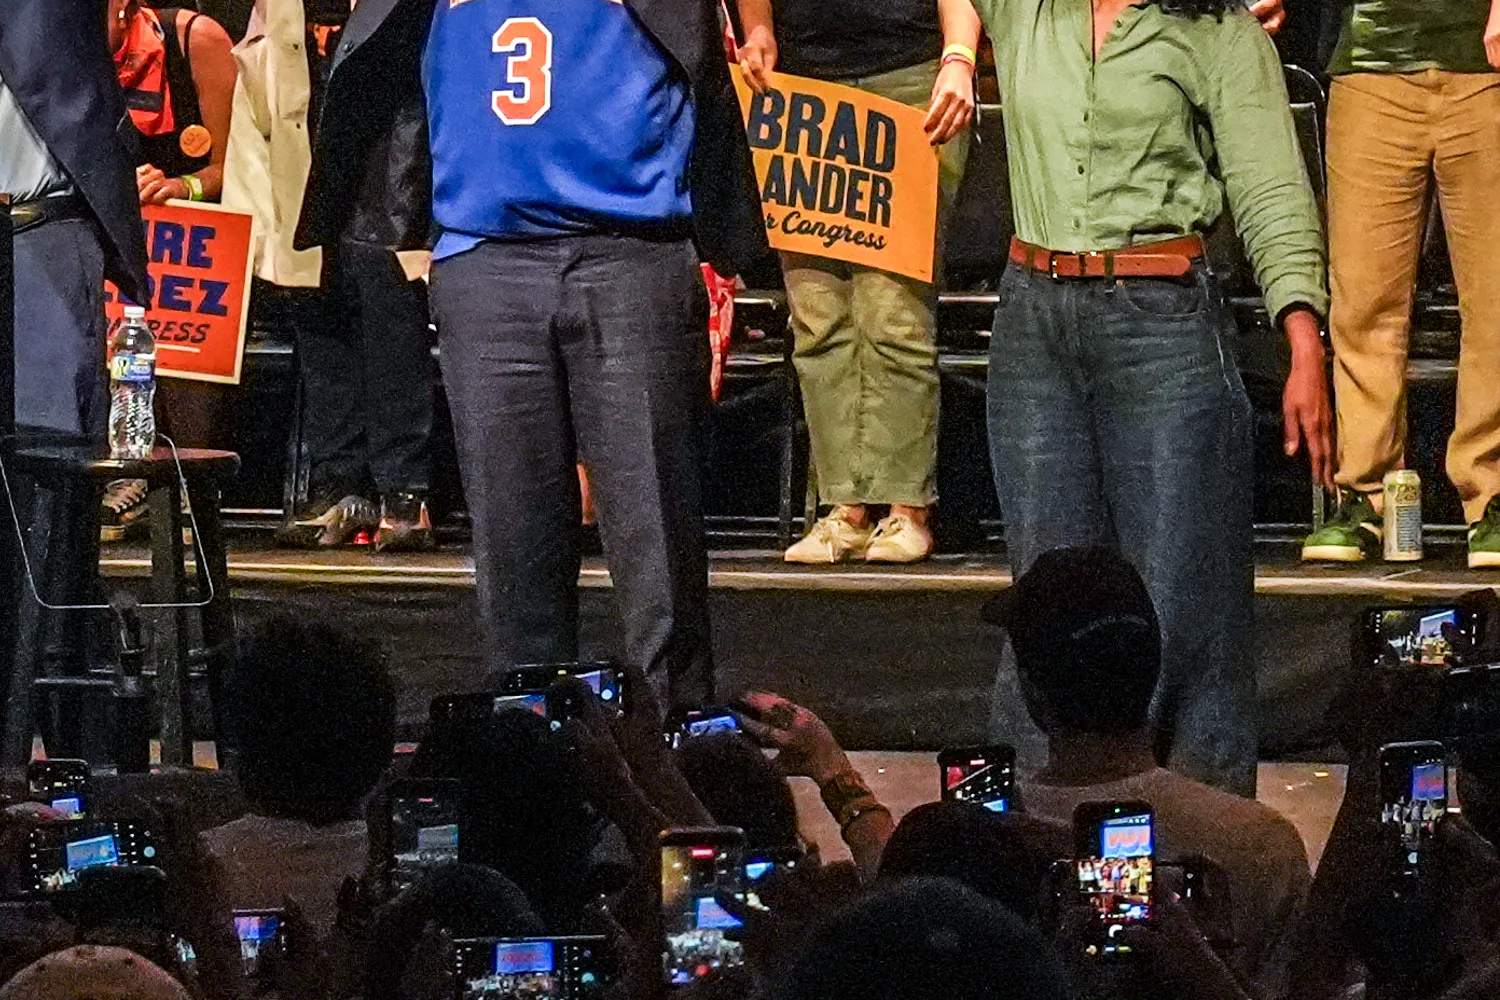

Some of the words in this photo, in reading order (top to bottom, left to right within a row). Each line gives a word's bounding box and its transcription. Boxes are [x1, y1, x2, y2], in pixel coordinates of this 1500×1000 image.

[491, 17, 553, 126] 3
[749, 87, 897, 173] BRAD
[762, 154, 893, 228] ANDER
[781, 210, 887, 250] Congress
